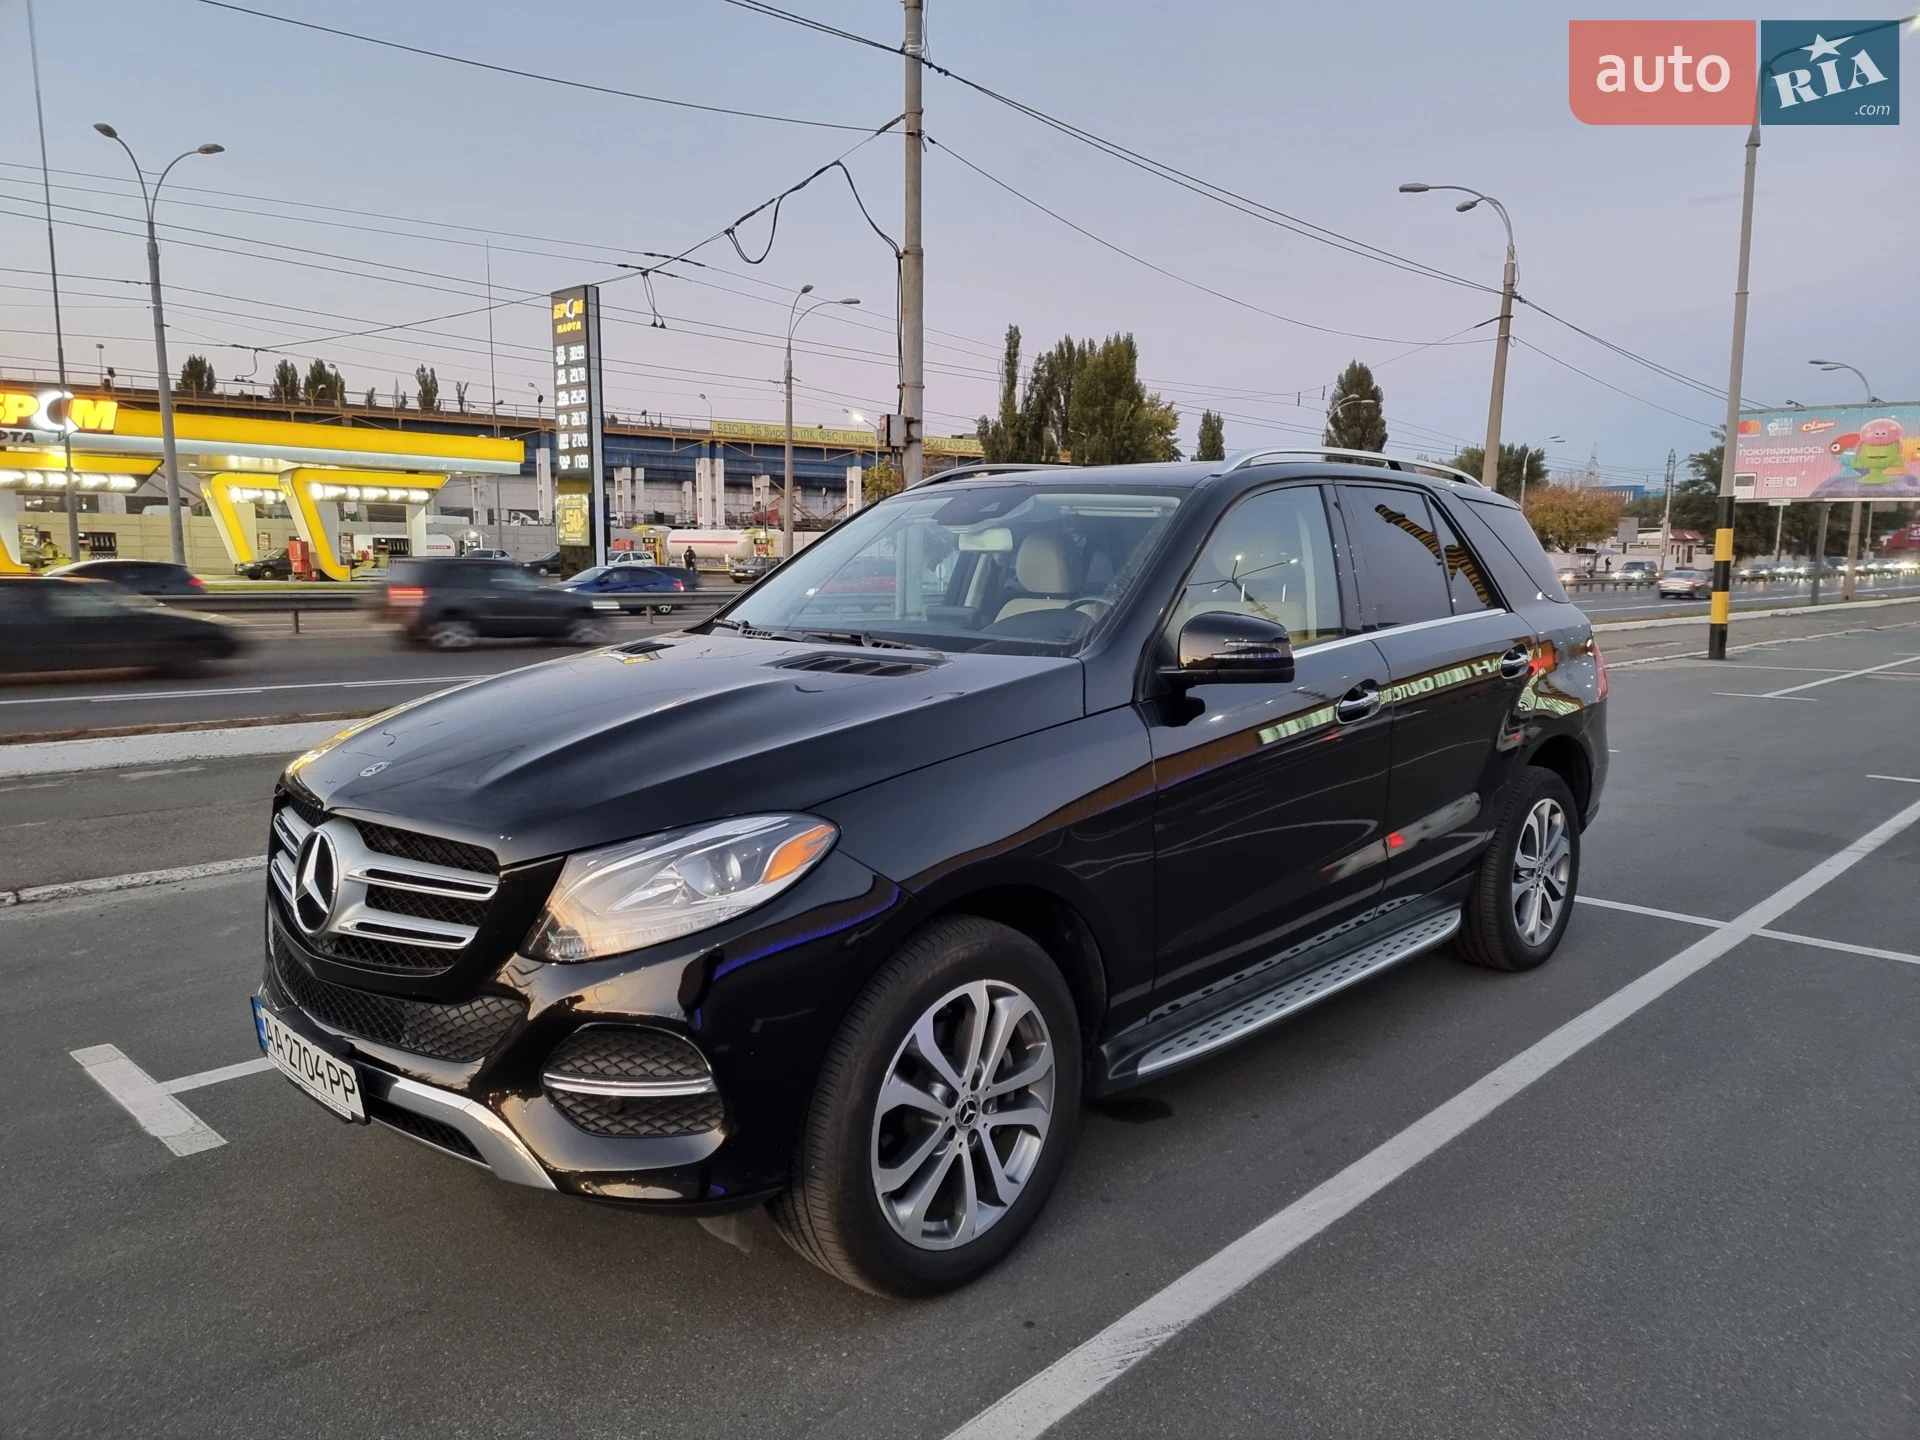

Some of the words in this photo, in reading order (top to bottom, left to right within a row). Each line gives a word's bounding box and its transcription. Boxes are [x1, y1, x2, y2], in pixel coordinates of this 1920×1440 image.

[556, 320, 582, 333] НАФТА
[0, 390, 119, 434] РСМ
[764, 426, 799, 440] Вирои
